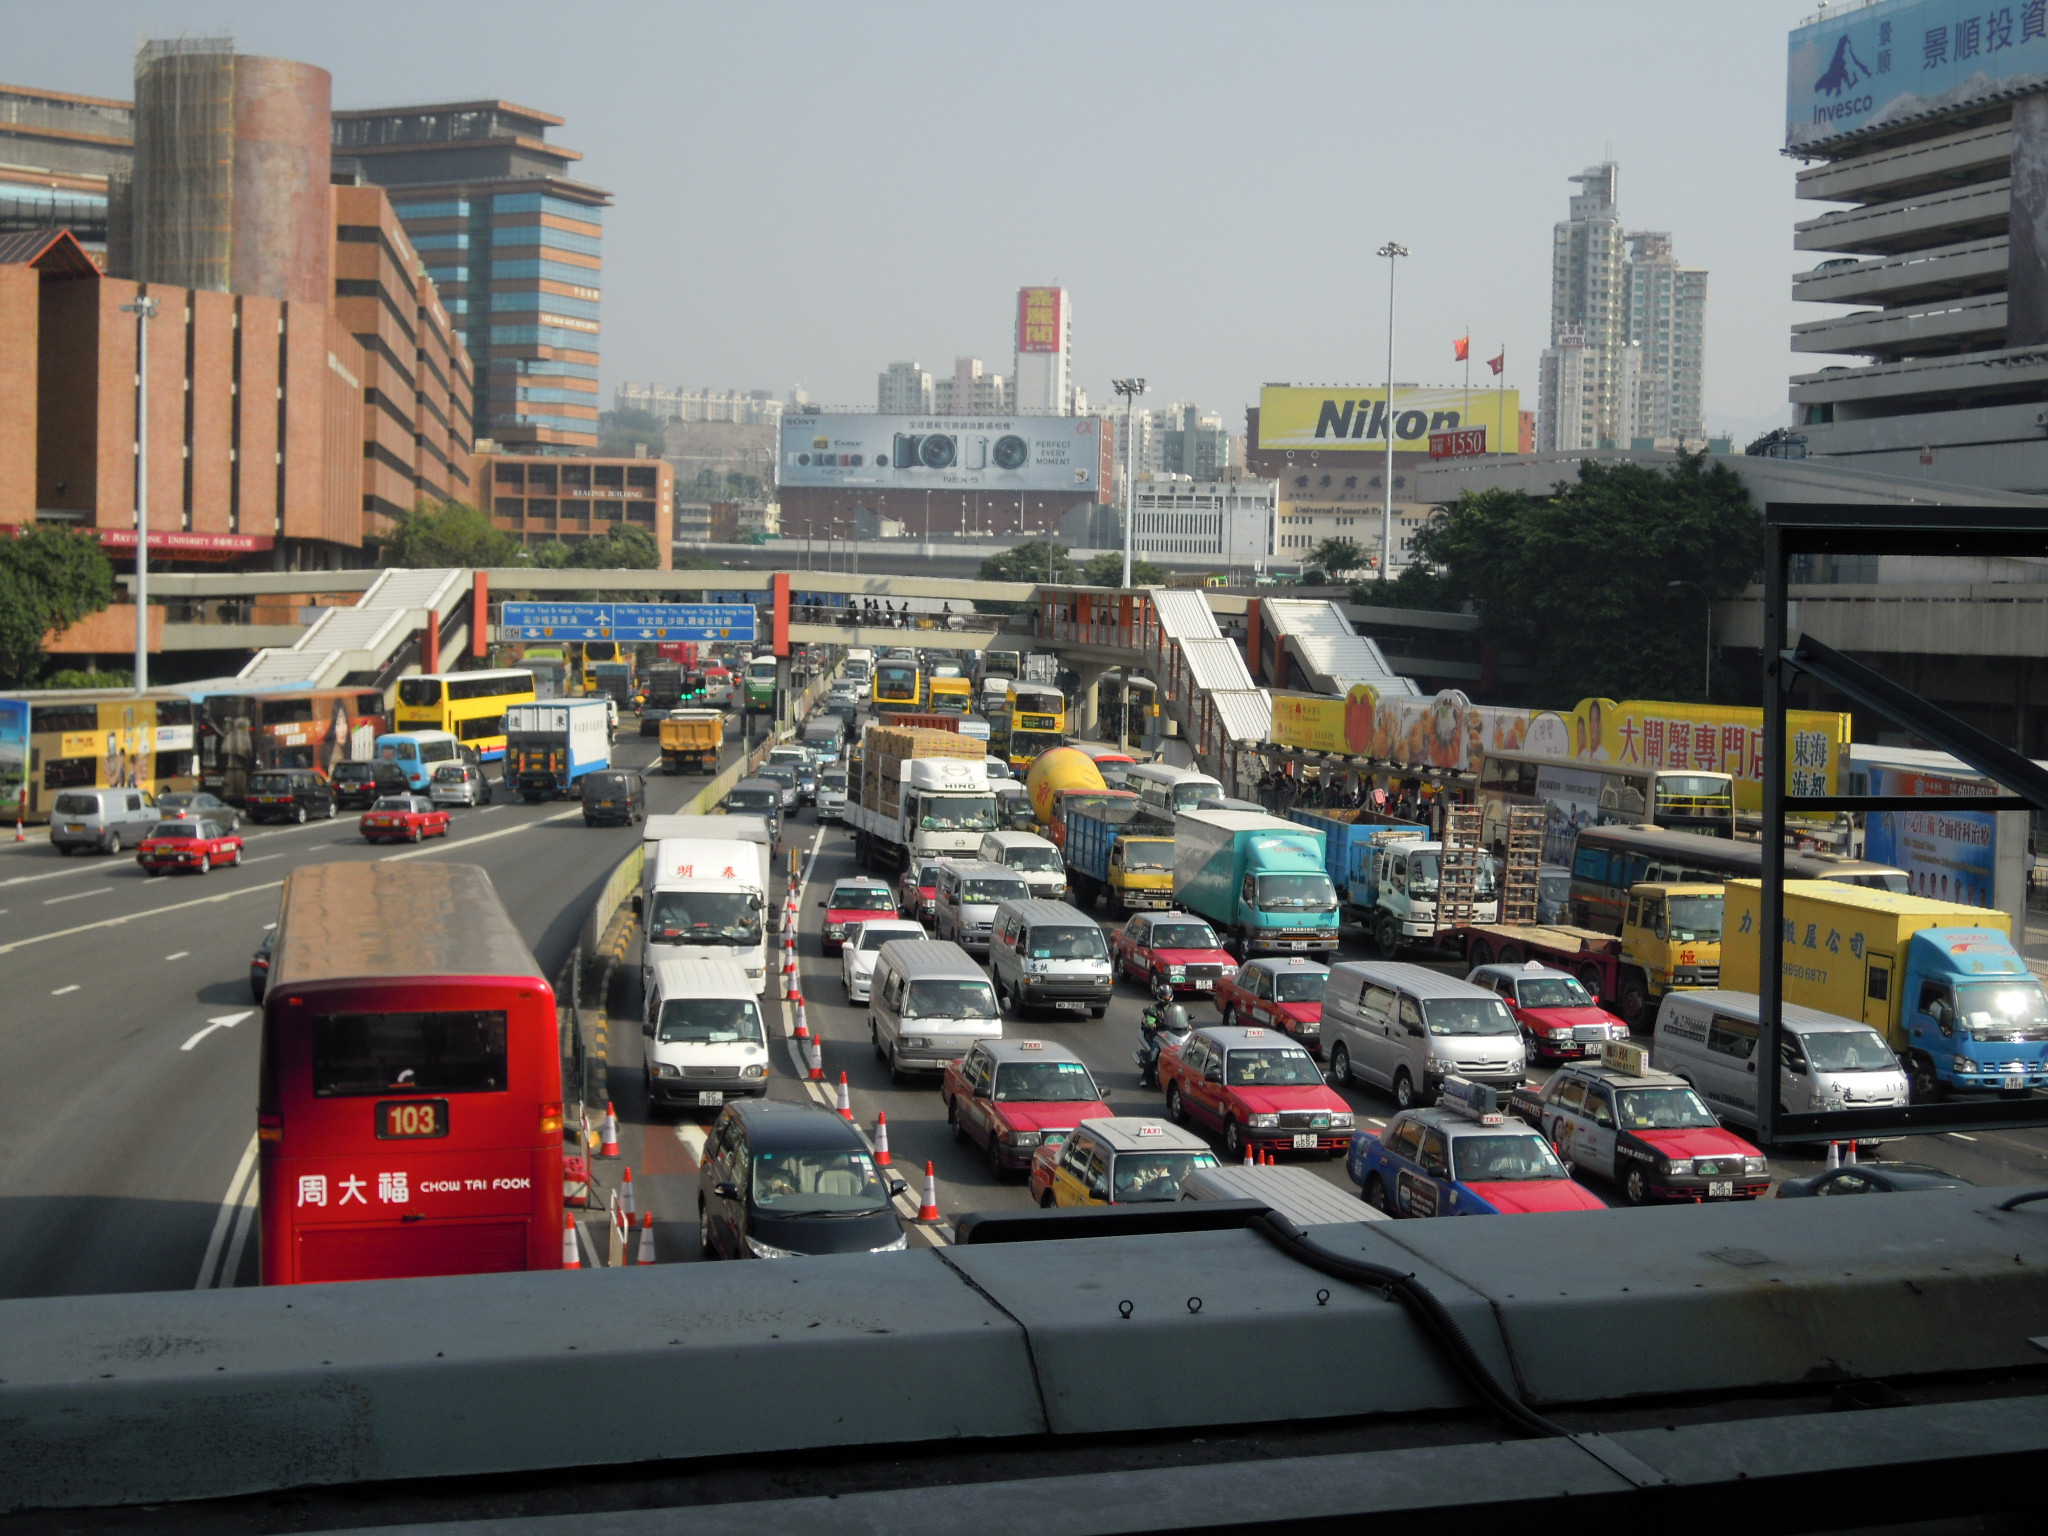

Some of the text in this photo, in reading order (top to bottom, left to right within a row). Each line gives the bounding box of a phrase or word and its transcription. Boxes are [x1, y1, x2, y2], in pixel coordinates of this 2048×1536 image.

[1922, 0, 2048, 71] 景順投資
[1876, 20, 1893, 75] 景順
[1313, 399, 1461, 441] Nikon
[1036, 440, 1071, 448] PERFECT
[1447, 431, 1482, 455] $1550
[943, 476, 979, 484] NEX-5
[572, 489, 643, 498] REALINK BUILDING
[1295, 506, 1334, 514] Universal
[1336, 506, 1369, 515] Funeral
[168, 536, 210, 546] UNIVERSITY
[574, 607, 594, 615] Chung
[1792, 731, 1828, 769] 東海
[677, 864, 737, 880] 明 泰
[1023, 1042, 1041, 1050] TAXI
[1885, 1082, 1905, 1092] 115
[390, 1105, 436, 1135] 103
[1142, 1127, 1162, 1135] TAXI
[297, 1171, 410, 1208] 周大福
[419, 1177, 531, 1193] CHOW TAI FOOK
